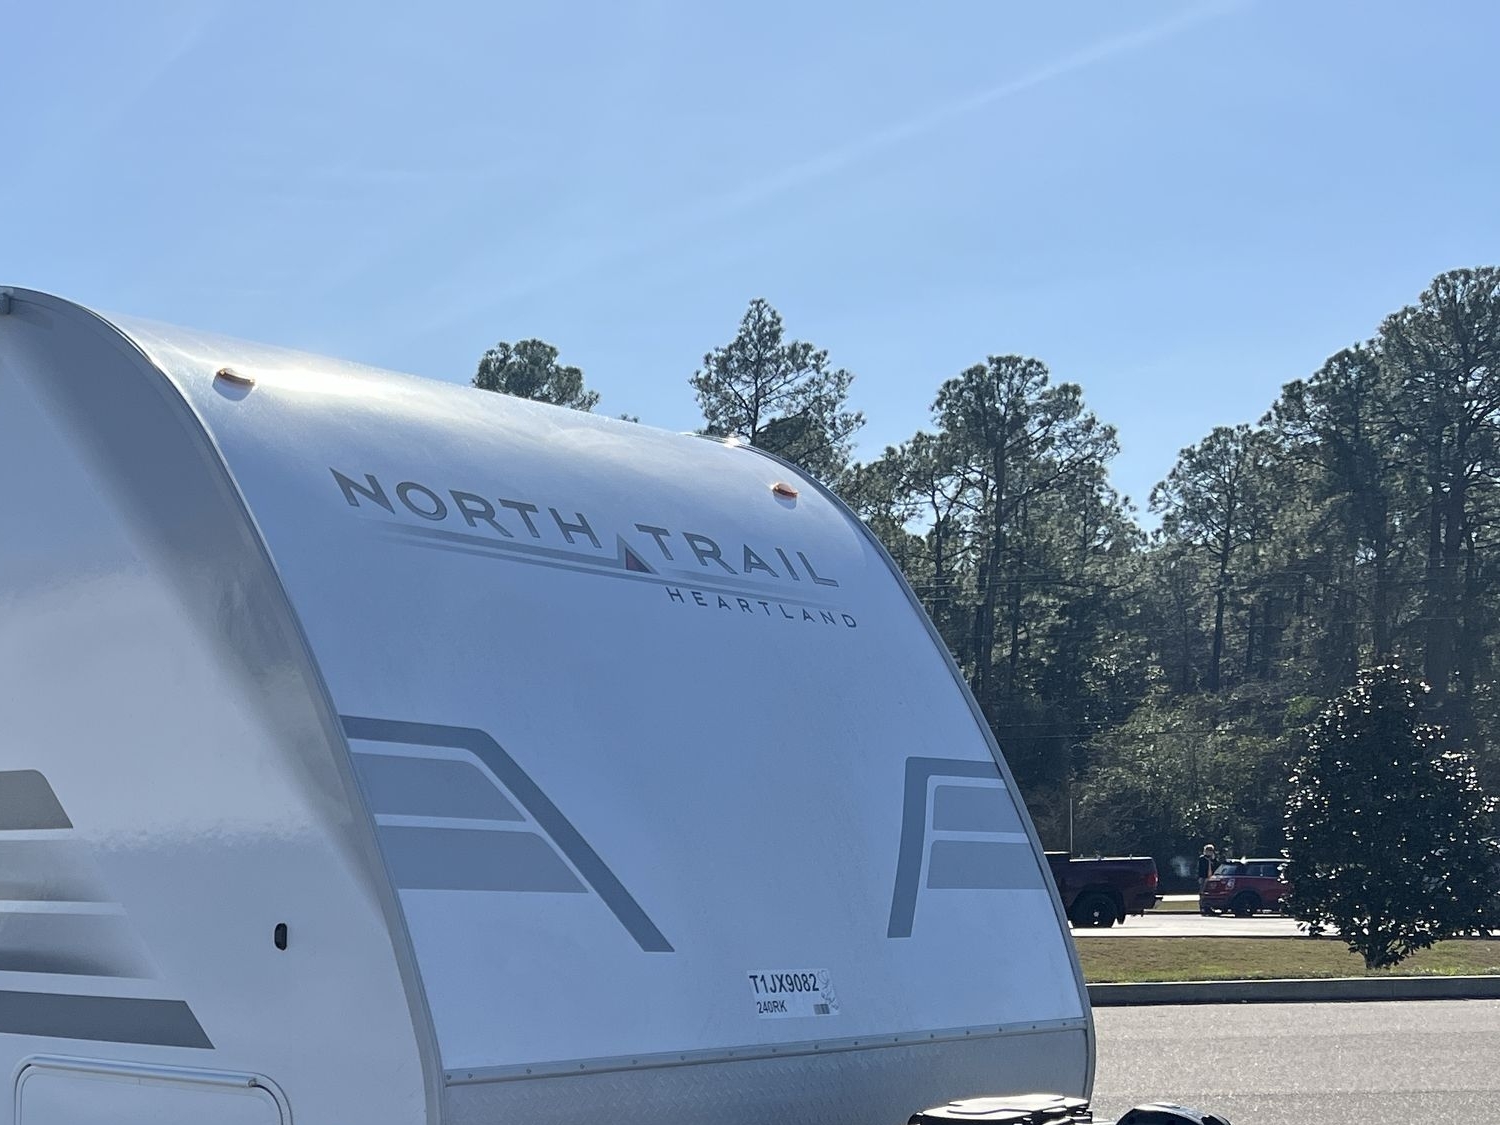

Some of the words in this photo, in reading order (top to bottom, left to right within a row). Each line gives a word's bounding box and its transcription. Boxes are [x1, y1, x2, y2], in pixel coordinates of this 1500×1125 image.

[329, 467, 603, 548] NORTH
[635, 523, 840, 587] TRAIL
[666, 587, 858, 628] HEARTLAND
[748, 973, 820, 994] T1JX9082
[756, 1000, 788, 1014] 240RK
